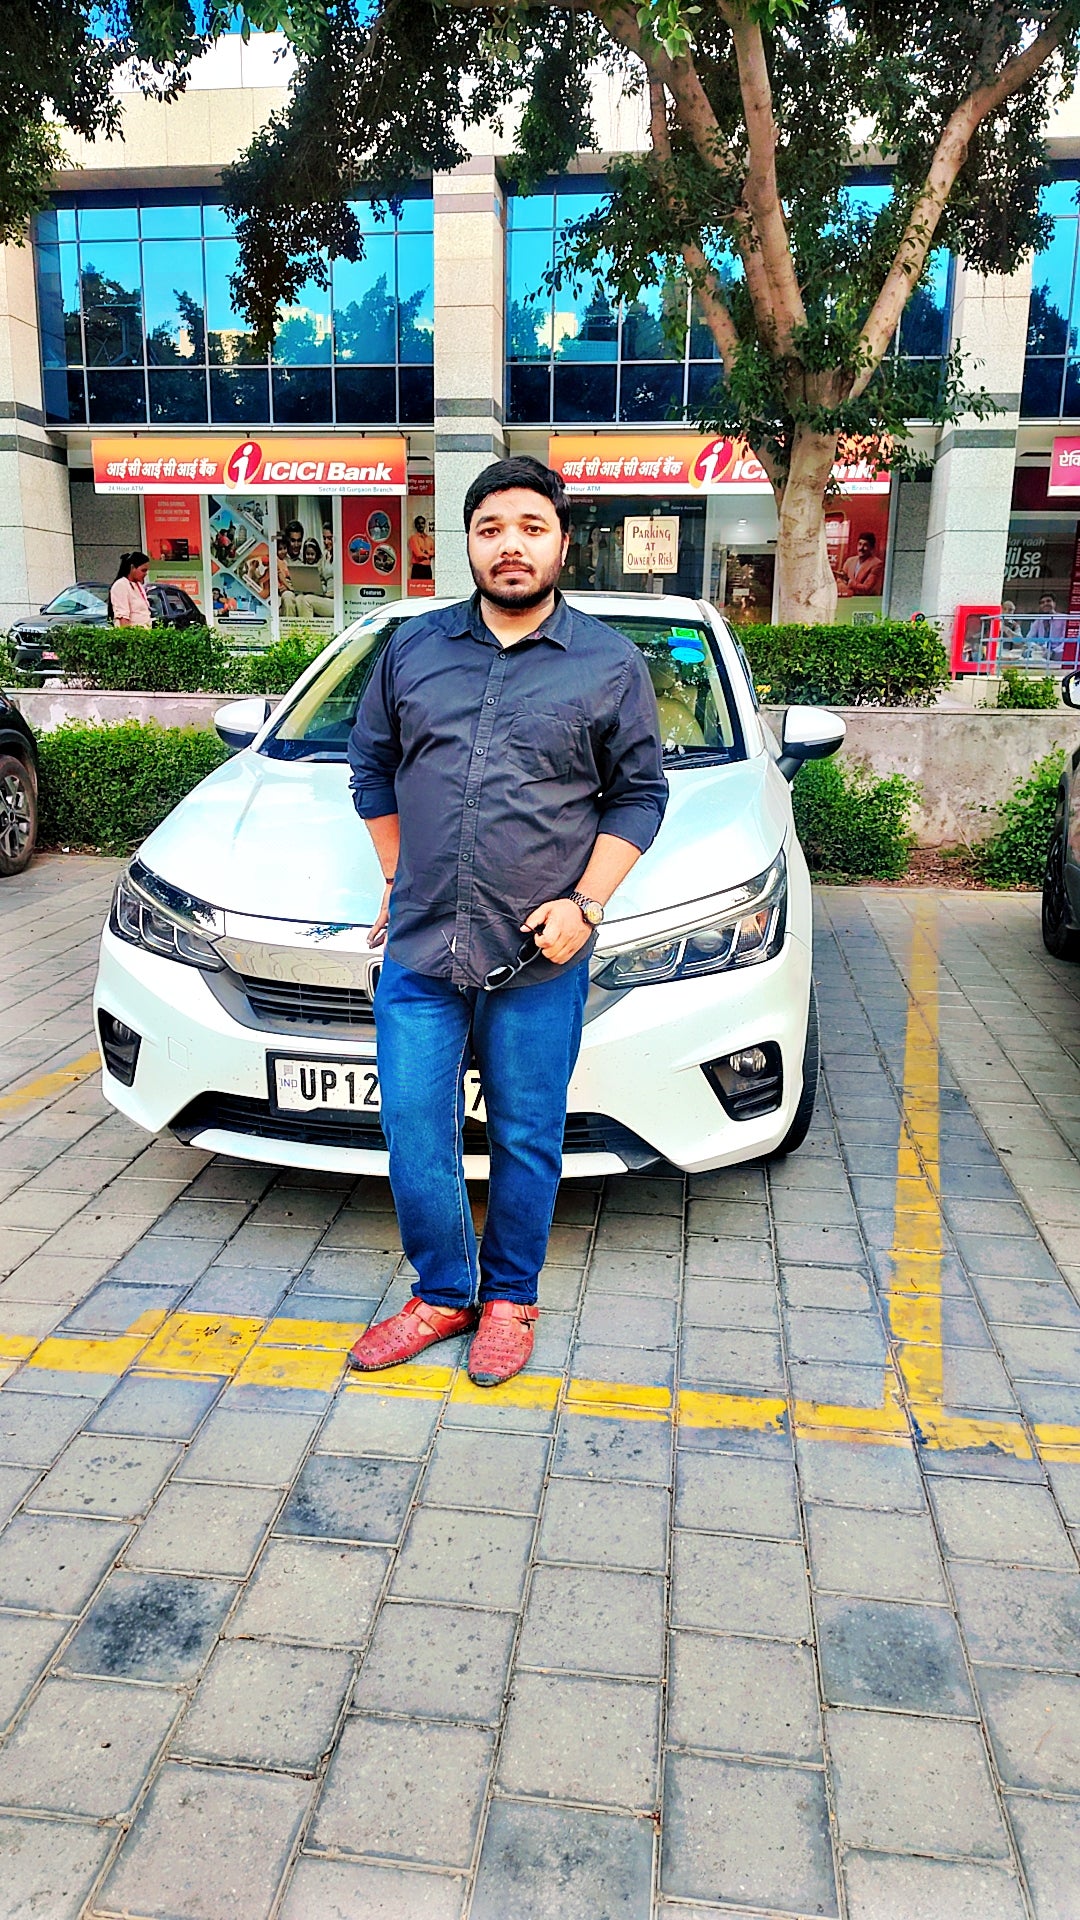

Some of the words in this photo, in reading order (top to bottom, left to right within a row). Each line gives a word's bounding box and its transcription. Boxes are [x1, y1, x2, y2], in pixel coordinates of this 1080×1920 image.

[107, 457, 128, 479] आई
[128, 457, 142, 476] सी
[142, 457, 163, 479] आई
[163, 457, 177, 476] सी
[177, 457, 198, 479] आई
[198, 457, 217, 476] बैंक
[262, 461, 325, 481] ICICI
[326, 461, 393, 481] Bank
[562, 456, 586, 478] आई
[586, 456, 600, 476] सी
[600, 456, 624, 478] आई
[624, 456, 638, 476] सी
[638, 456, 663, 478] आई
[662, 456, 684, 476] बैंक
[347, 486, 372, 495] Gurgaon
[645, 542, 656, 551] AT
[1022, 552, 1041, 564] se
